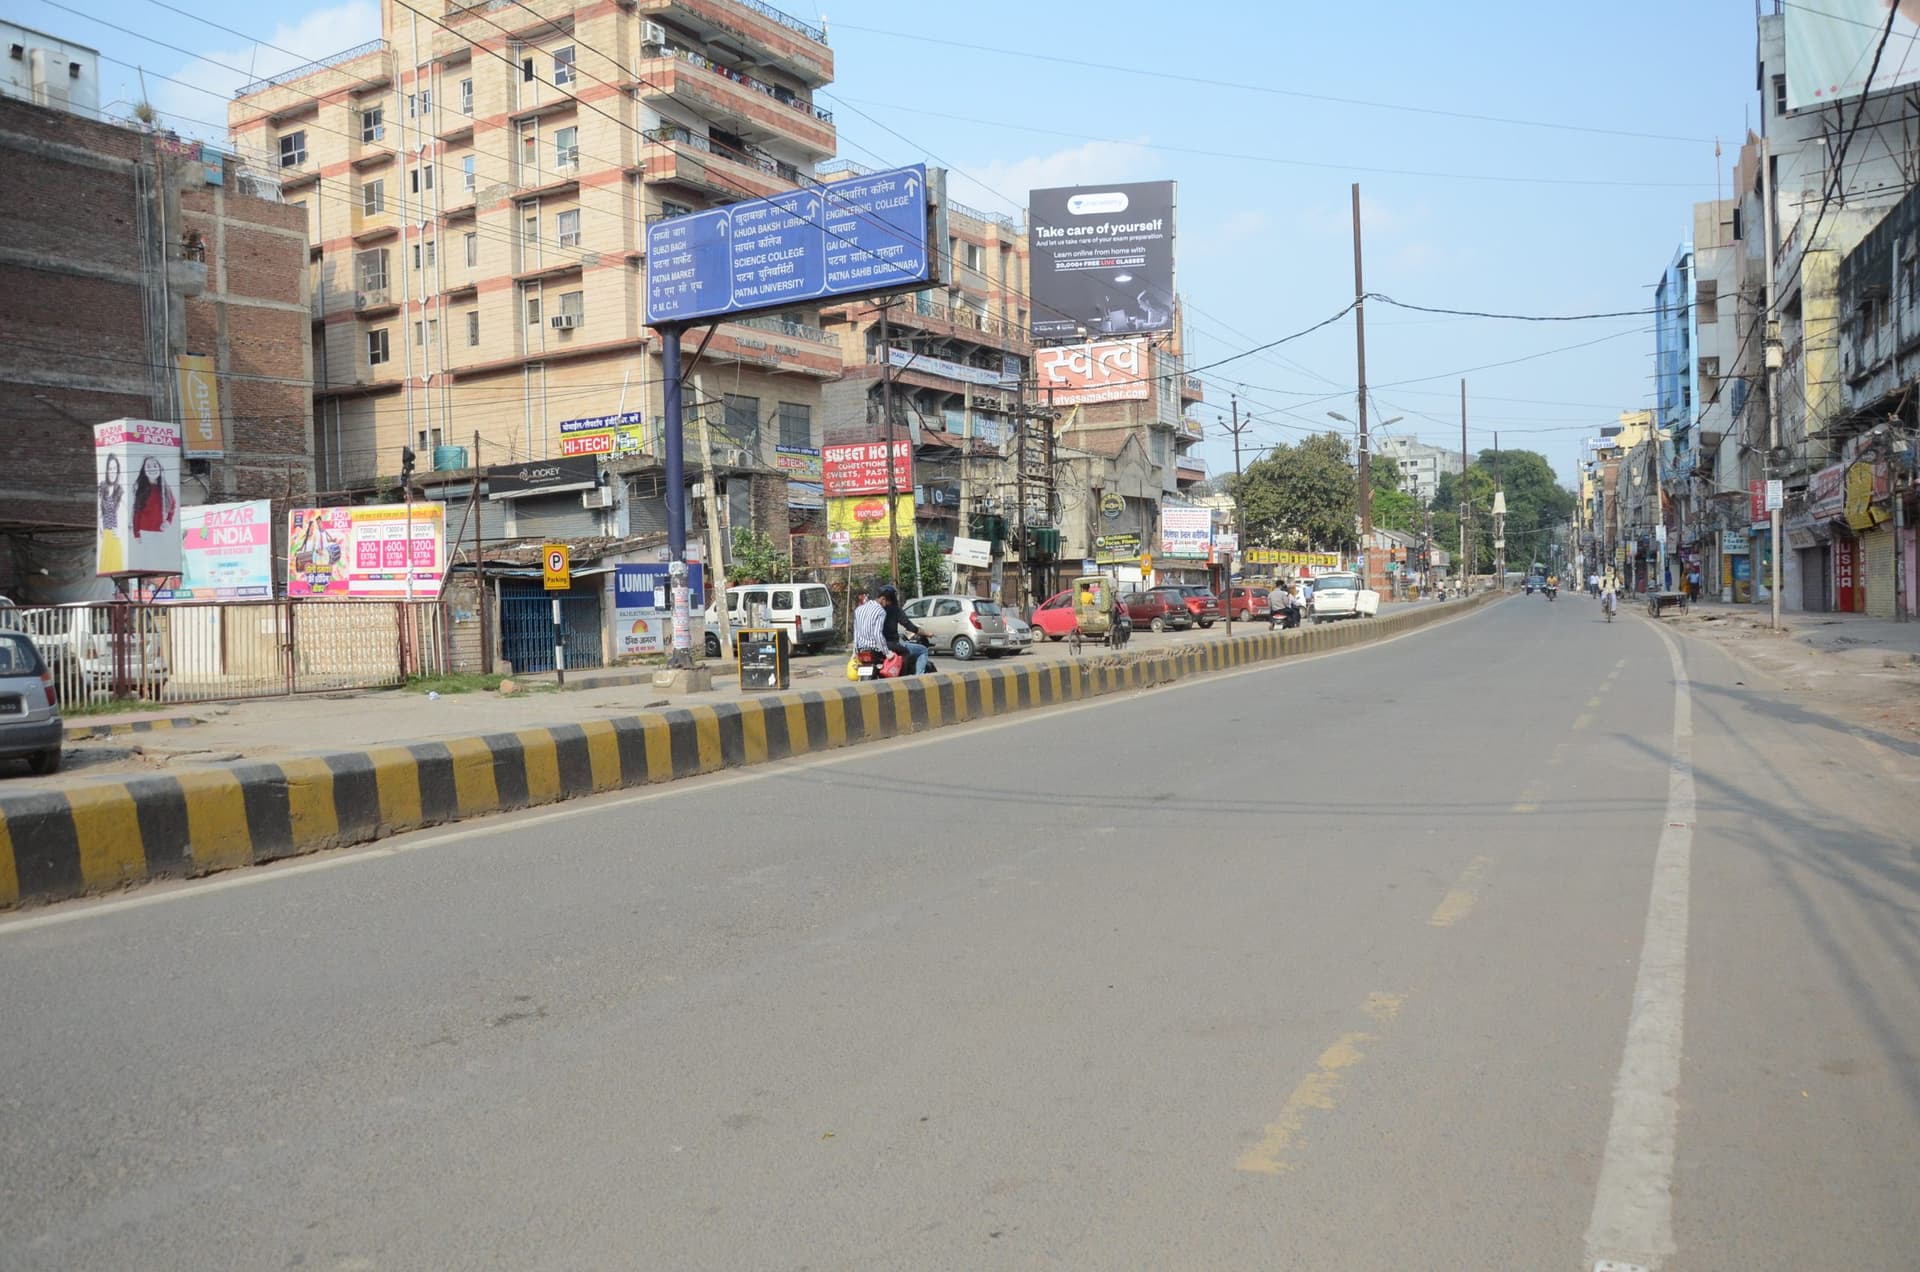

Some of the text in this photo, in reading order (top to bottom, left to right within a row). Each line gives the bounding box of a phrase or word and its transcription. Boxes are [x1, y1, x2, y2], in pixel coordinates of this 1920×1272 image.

[826, 195, 909, 220] ENGINEERING COLLEGE
[734, 215, 812, 238] KHUDA BAKSH LIBRARY
[1036, 219, 1163, 239] Take care of yourself
[826, 237, 858, 251] GAI GHAT
[1099, 236, 1112, 245] your
[1129, 233, 1163, 242] preparation
[734, 247, 805, 268] SCIENCE COLLEGE
[828, 254, 847, 265] पटना
[1054, 251, 1073, 259] Learn
[1073, 249, 1093, 258] online
[1094, 248, 1110, 257] from
[1131, 246, 1146, 254] with
[1101, 258, 1115, 266] LIVE
[1116, 257, 1145, 265] CLASSES
[652, 268, 695, 284] PATNA MARKET
[736, 271, 754, 282] पटना
[828, 259, 919, 281] PATNA SAHIB GURUDWARA
[734, 278, 805, 298] PATNA UNIVERSITY
[100, 424, 123, 437] BAZAR
[136, 424, 174, 436] BAZAR
[563, 436, 609, 455] HI-TECH
[825, 446, 866, 463] SWEET
[531, 466, 561, 478] JOCKEY
[865, 467, 905, 477] PASTES
[203, 507, 254, 526] BAZAR
[413, 551, 431, 559] EXTRA
[552, 554, 561, 569] P
[1841, 543, 1853, 588] USHA
[547, 576, 567, 585] Parking
[619, 573, 668, 593] LUMIN
